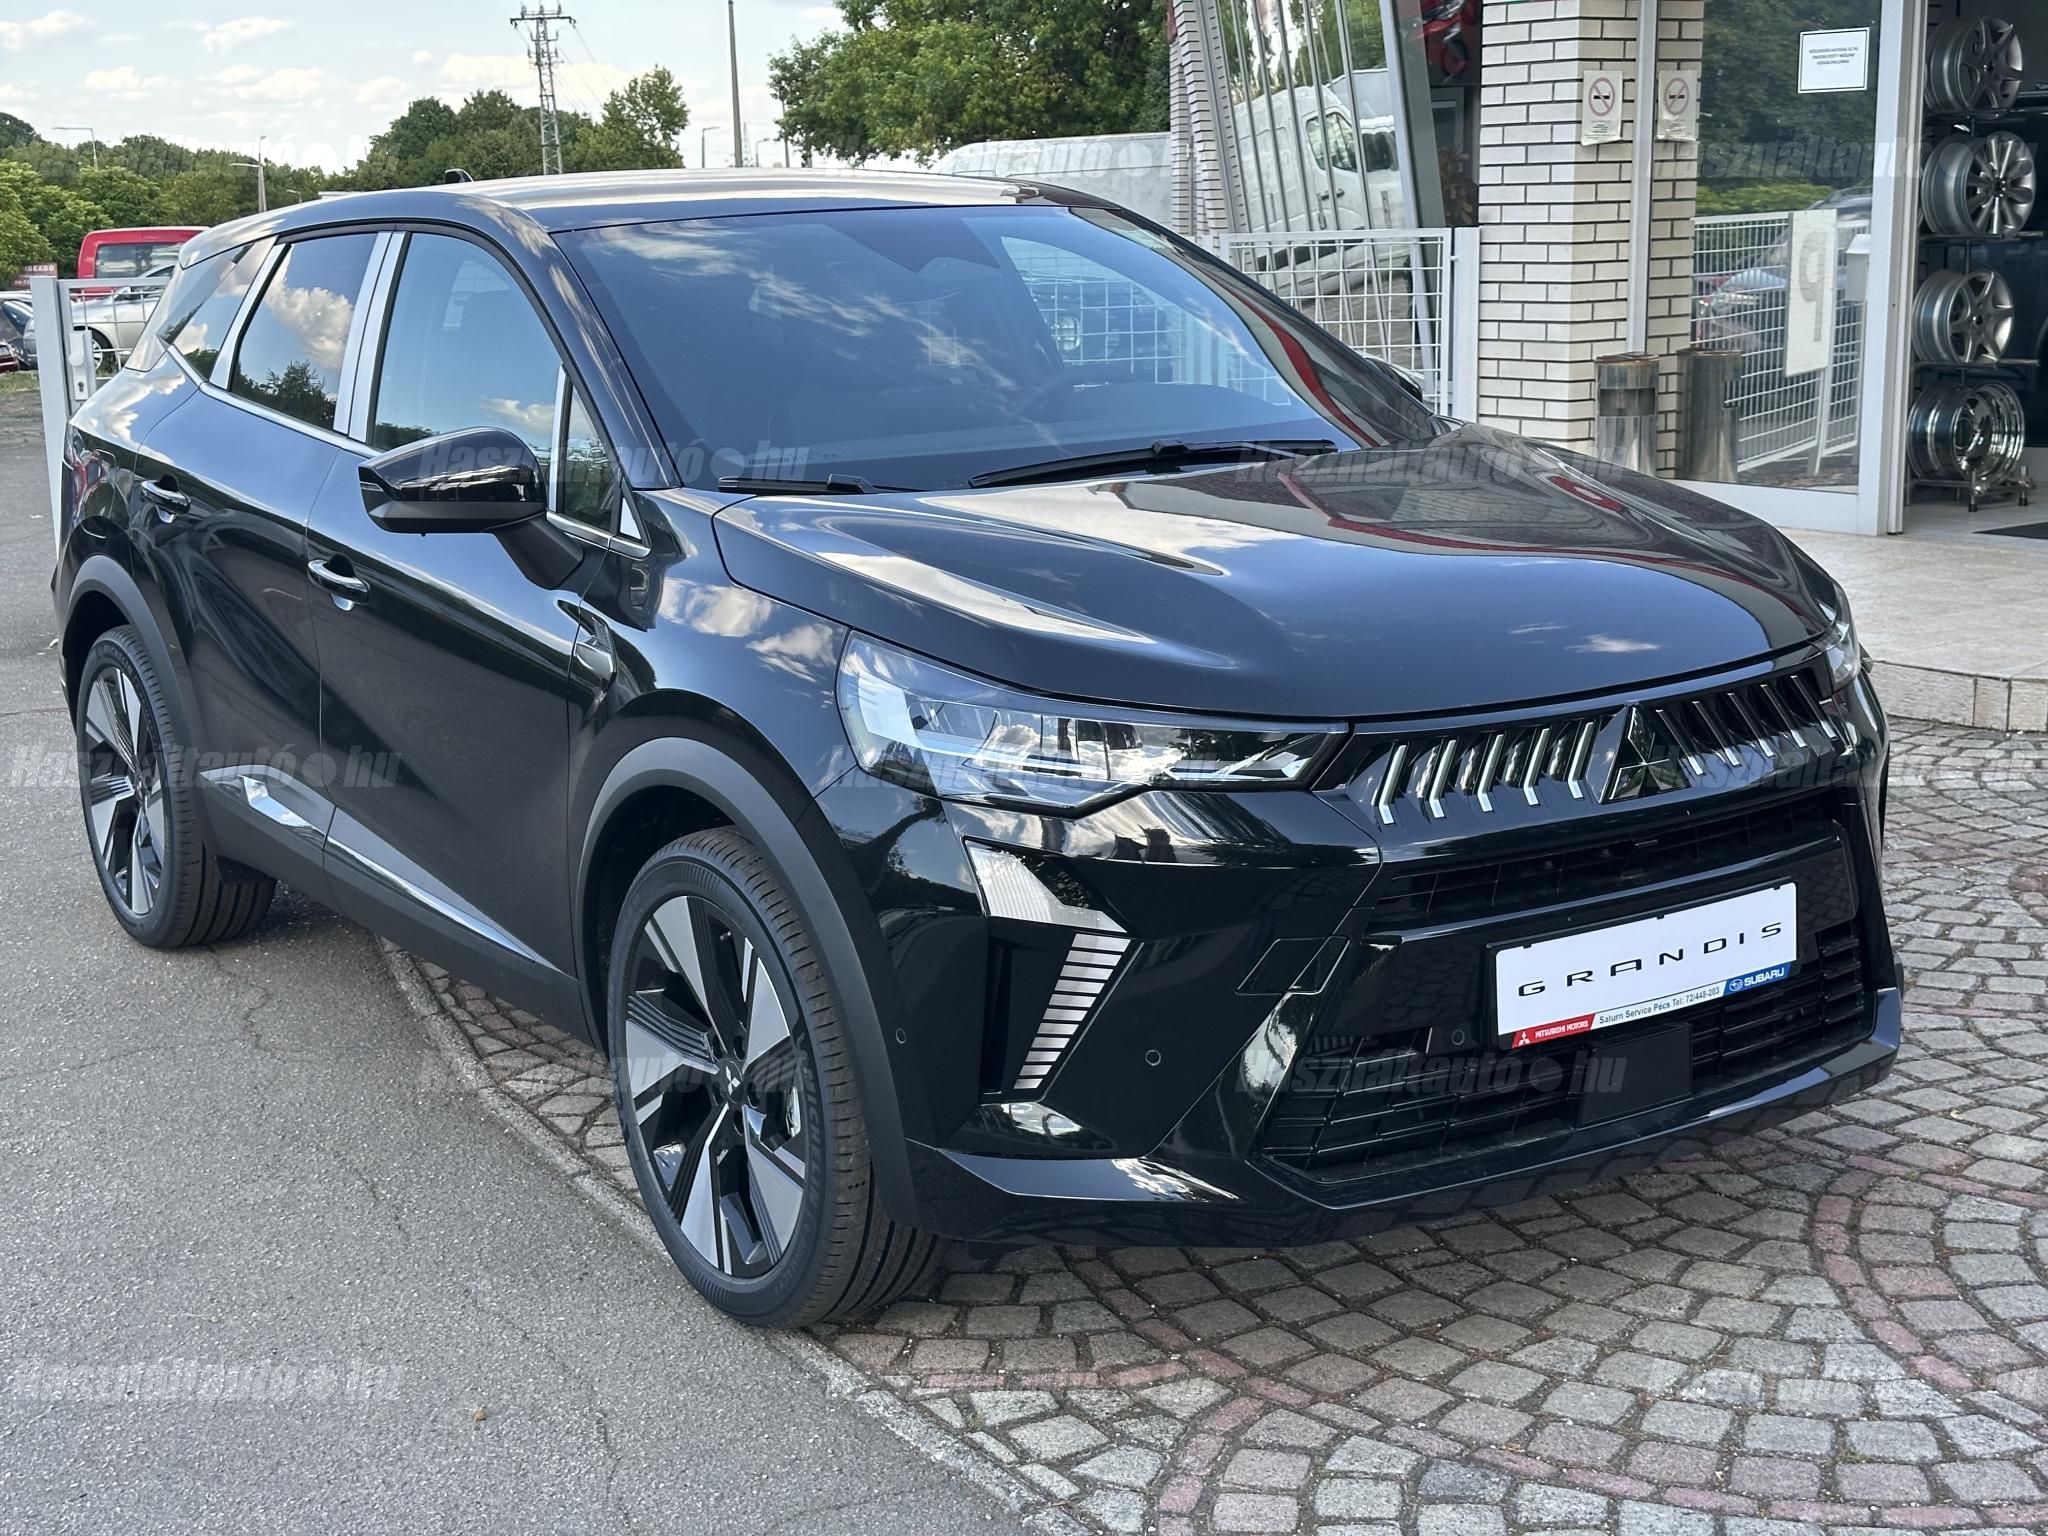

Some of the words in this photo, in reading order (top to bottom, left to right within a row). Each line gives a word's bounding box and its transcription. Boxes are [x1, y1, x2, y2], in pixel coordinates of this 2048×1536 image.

[1518, 922, 1782, 997] GRANDIS
[1743, 967, 1785, 988] SUBARU
[1599, 1012, 1624, 1025] Saturn
[1625, 1006, 1652, 1018] Service
[1535, 1026, 1566, 1039] MITSUBISHI
[1566, 1020, 1589, 1032] MOTORS
[804, 1068, 823, 1207] MICHELIN
